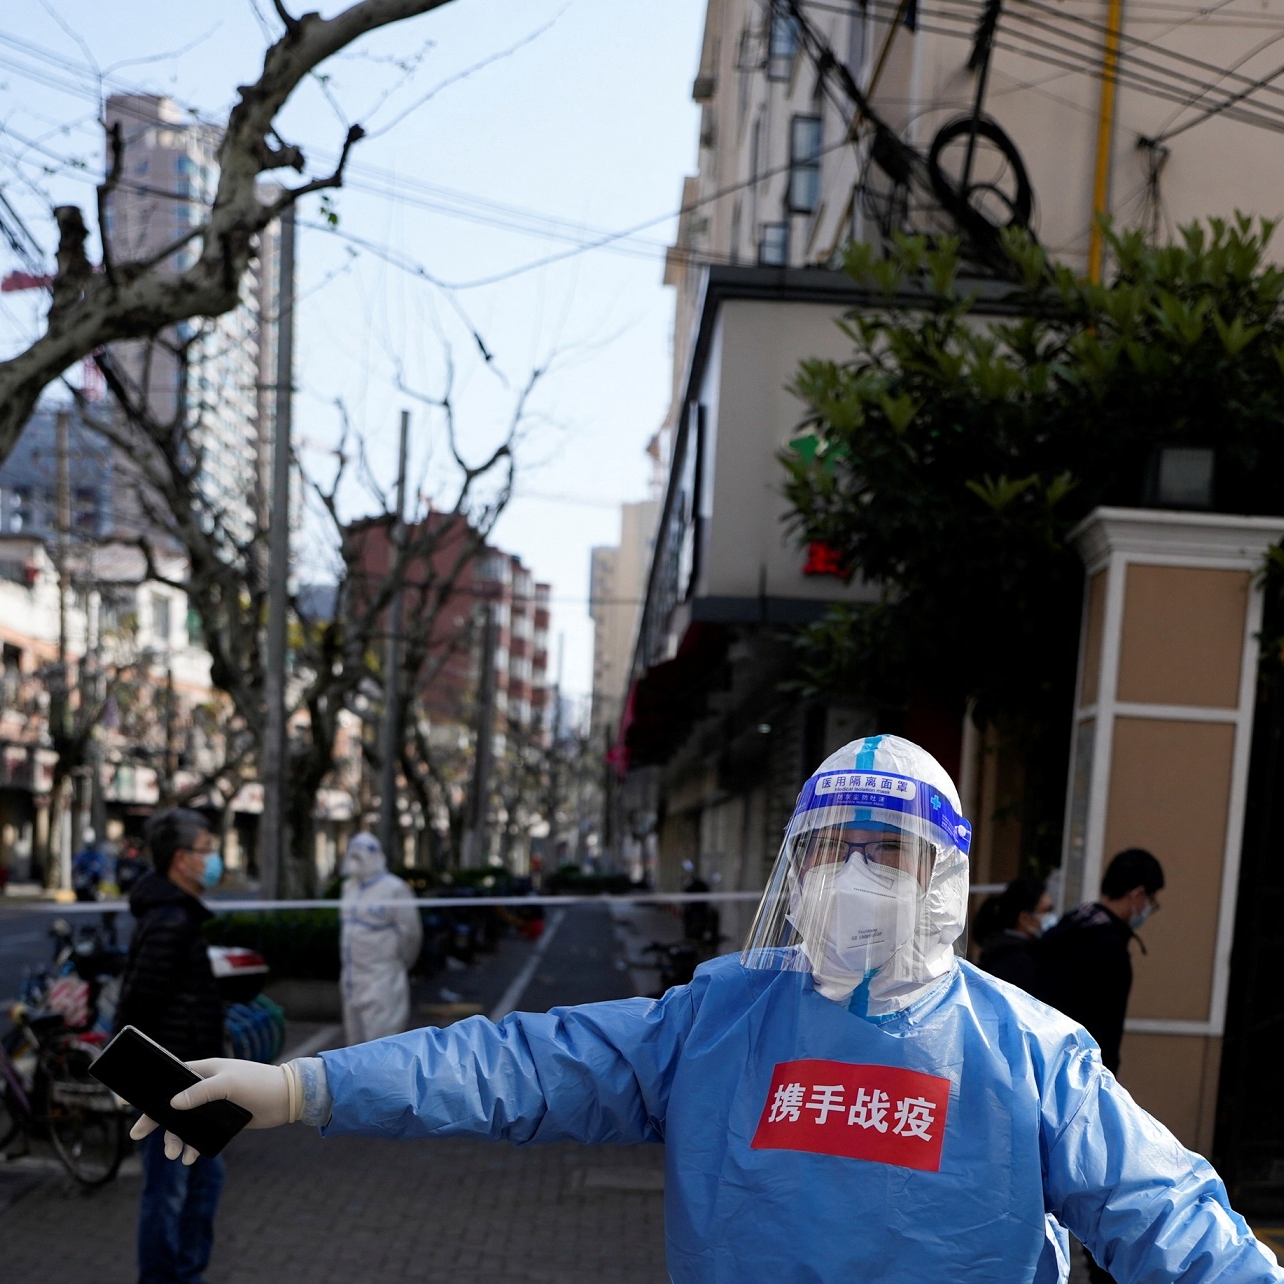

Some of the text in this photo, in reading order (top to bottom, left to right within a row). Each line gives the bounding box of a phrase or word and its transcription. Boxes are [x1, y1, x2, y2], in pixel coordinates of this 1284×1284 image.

[821, 775, 909, 793] 医用隔离面罩
[767, 1081, 937, 1142] 携手战疫
